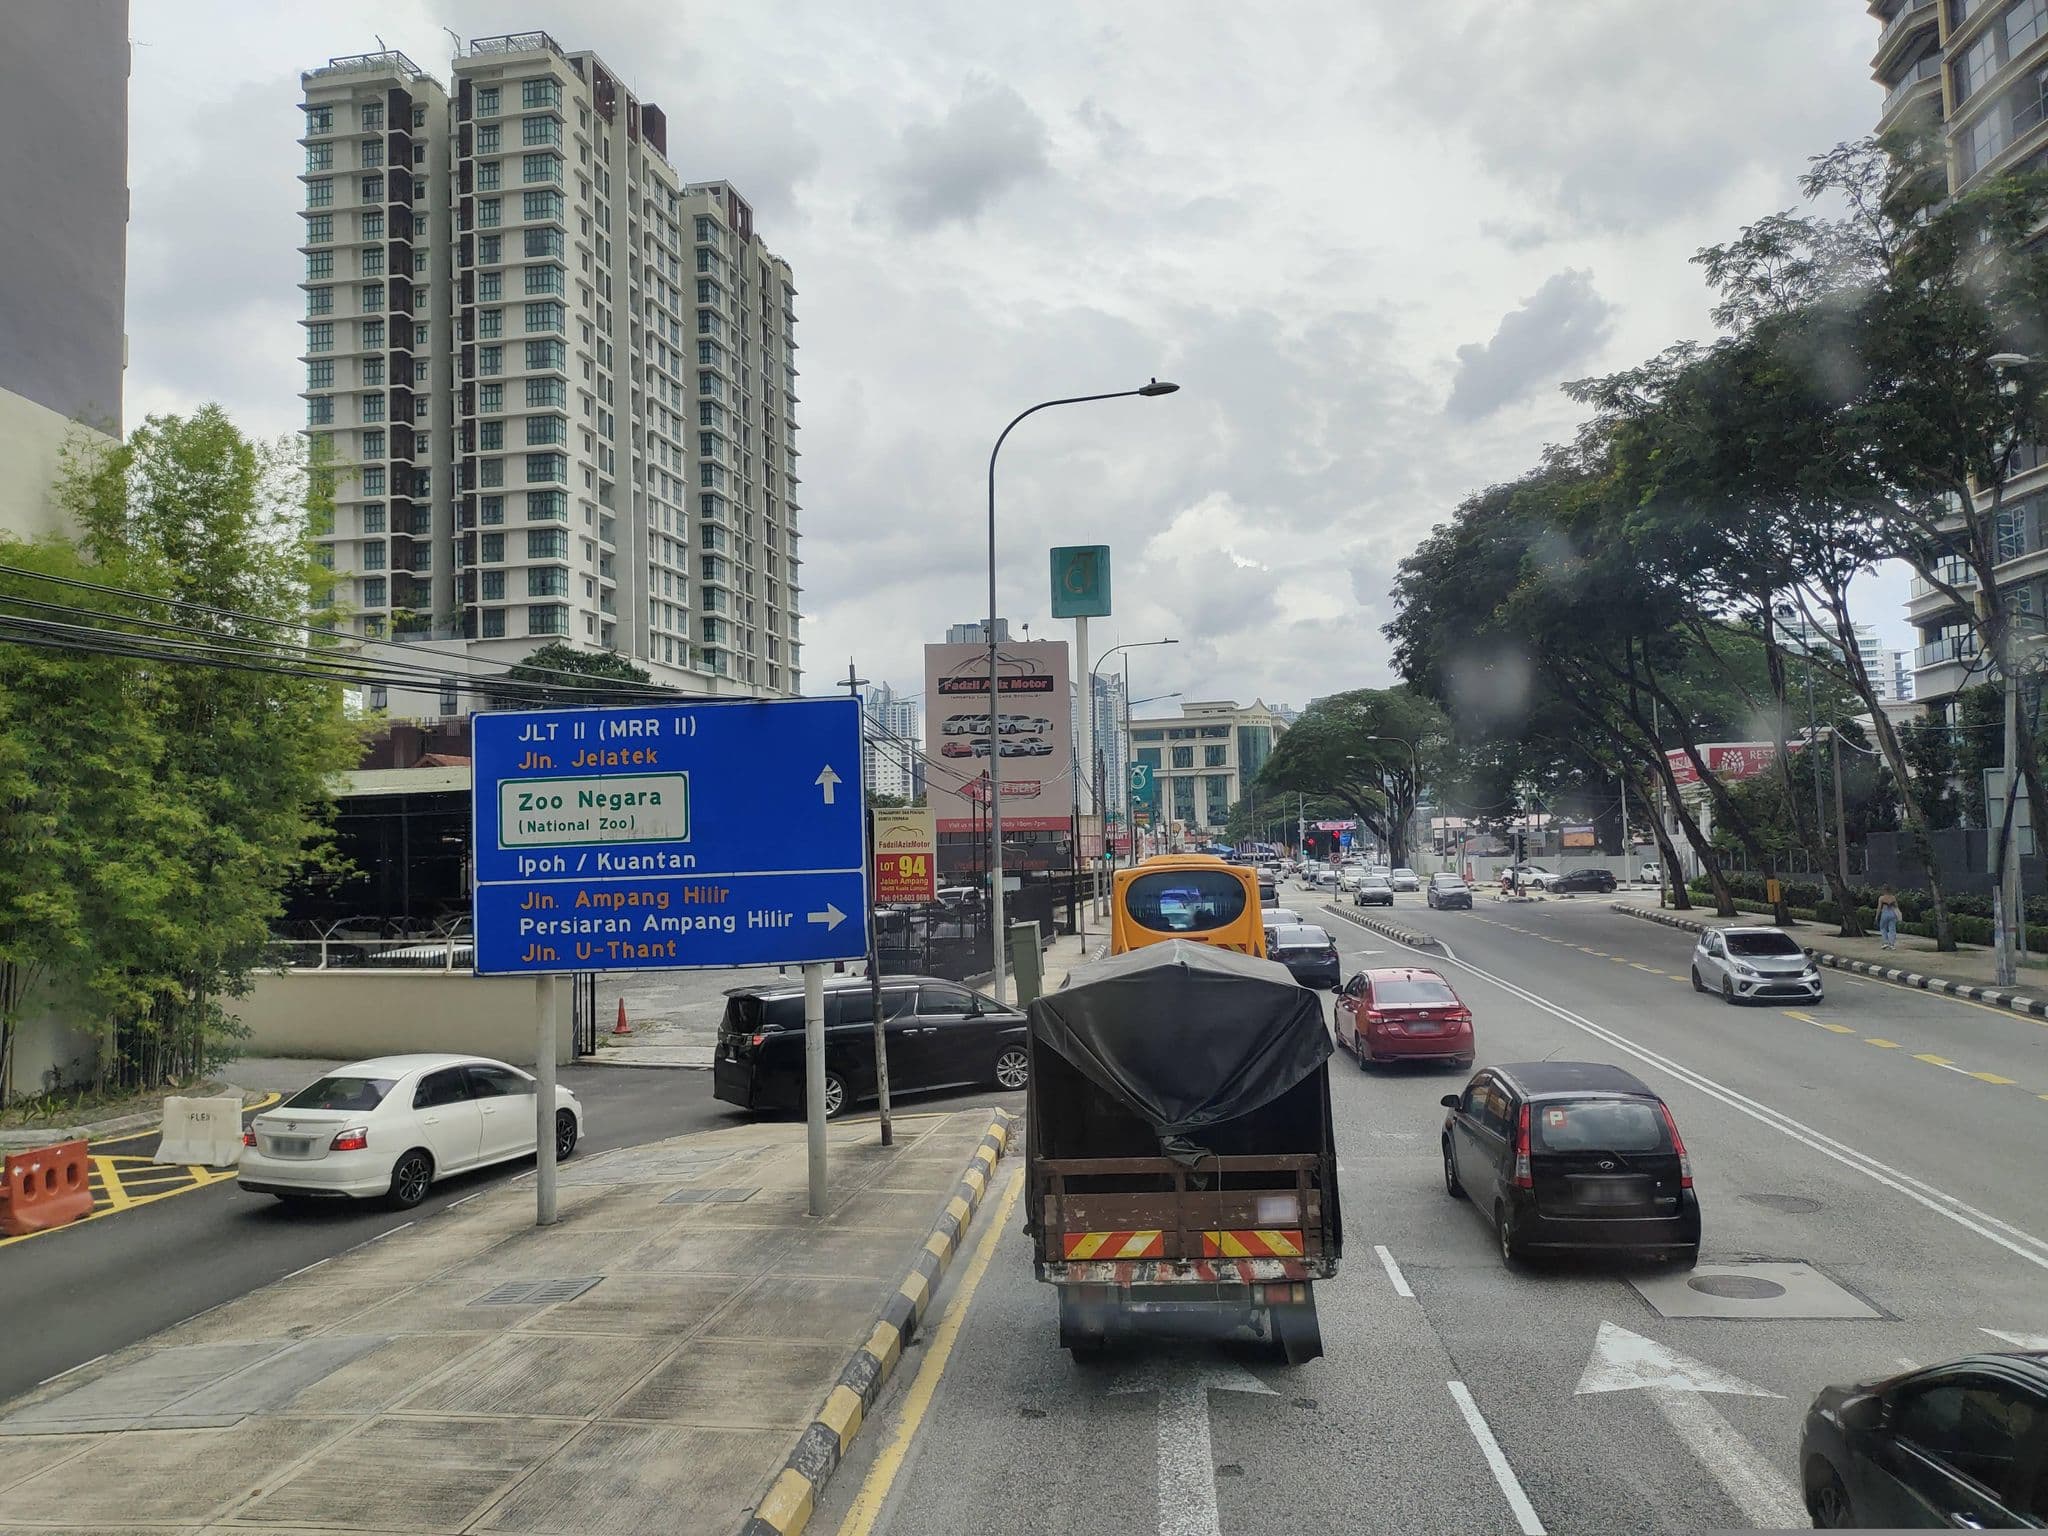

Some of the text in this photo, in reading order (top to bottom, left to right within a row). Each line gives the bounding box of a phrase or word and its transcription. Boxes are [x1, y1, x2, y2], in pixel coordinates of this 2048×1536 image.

[982, 680, 1008, 690] Aiz
[1011, 679, 1048, 689] Motor
[518, 715, 697, 742] JLT II (MRR II)
[518, 748, 658, 770] Jln. Jelatek
[518, 789, 662, 811] Zoo Negara
[518, 815, 635, 835] (National Zoo)
[879, 840, 930, 849] FadzilAzizMotor
[518, 851, 696, 877] Ipoh / Kuantan
[880, 855, 927, 878] LOT 94
[880, 877, 929, 886] Jalan Ampang
[521, 886, 730, 911] Jln. Ampang Hilir
[520, 909, 794, 936] Persiaran Ampang Hilir
[522, 939, 677, 963] Jln. U-Thant
